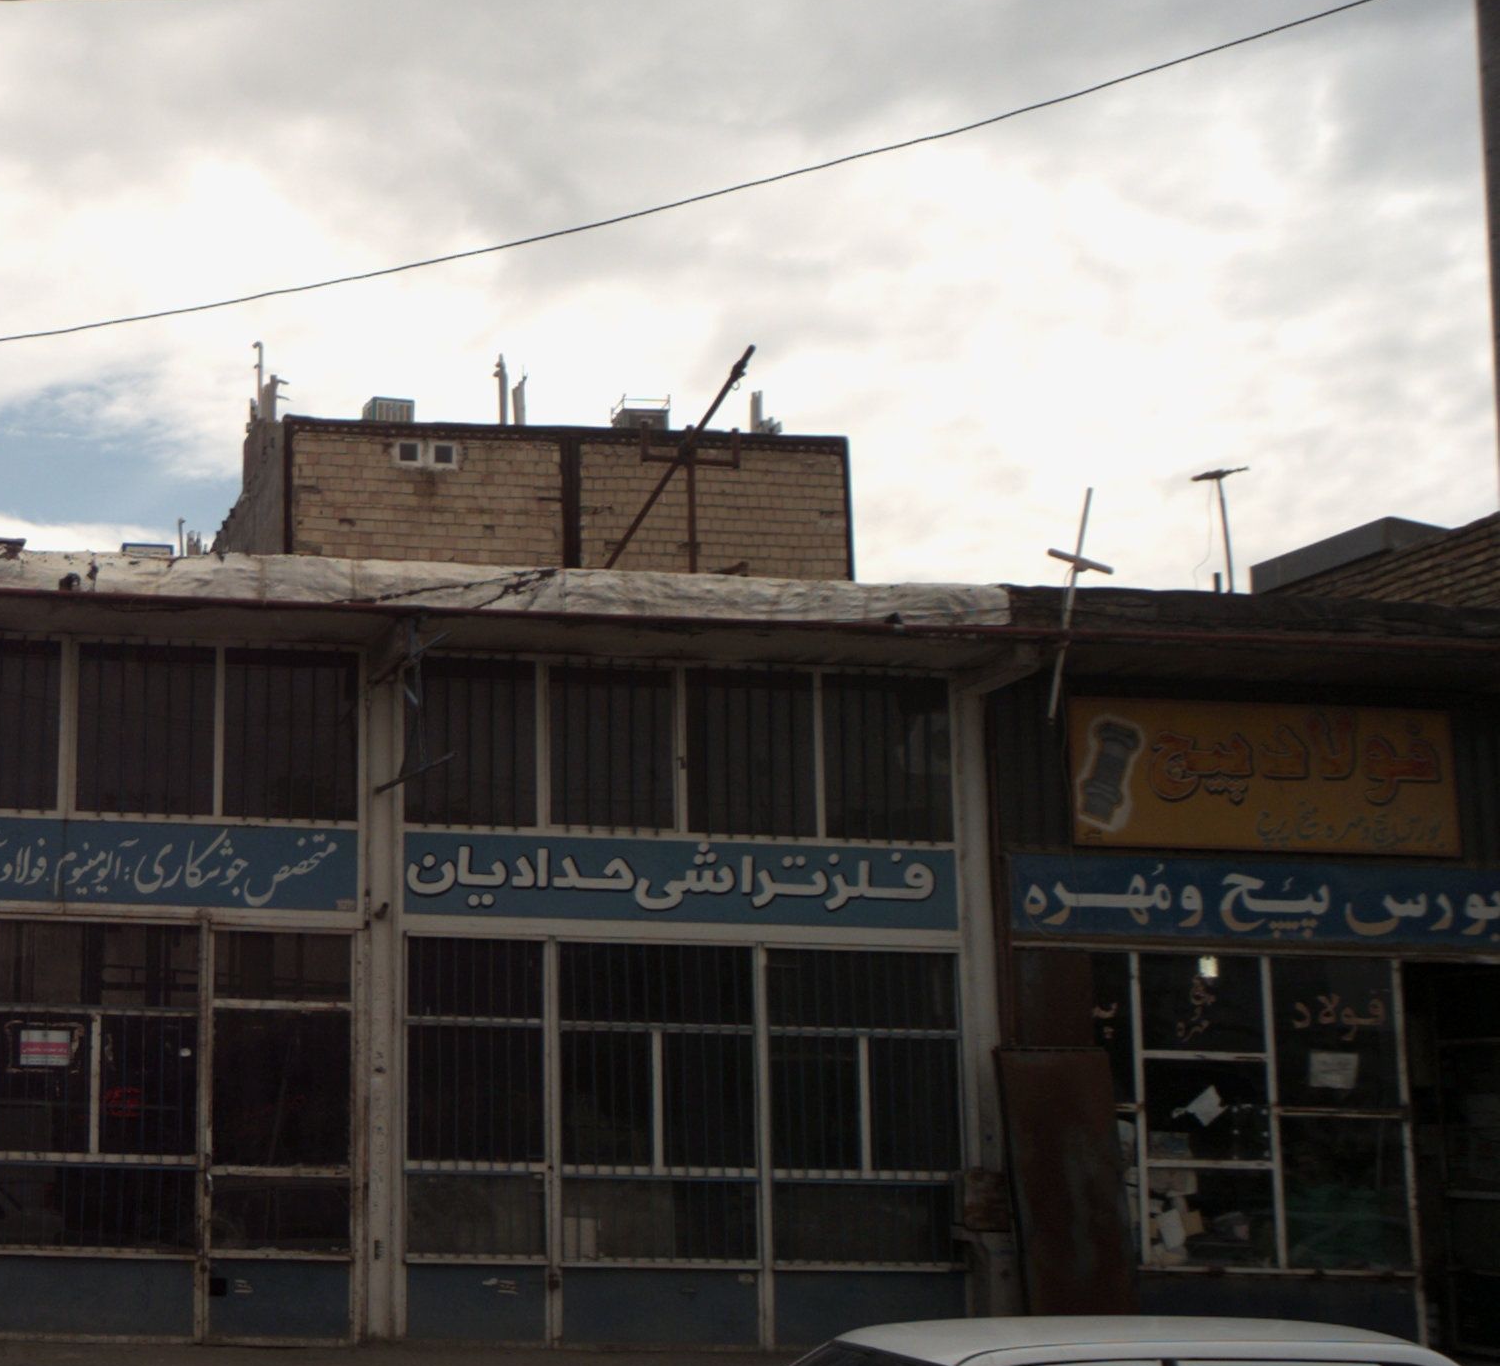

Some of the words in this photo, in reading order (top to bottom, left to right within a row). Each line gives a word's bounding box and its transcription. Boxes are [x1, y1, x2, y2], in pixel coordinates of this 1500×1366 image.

[1147, 730, 1254, 804] پیچ
[1259, 709, 1443, 805] فولاد
[0, 838, 48, 885] فولاد
[406, 845, 636, 908] حدادیان
